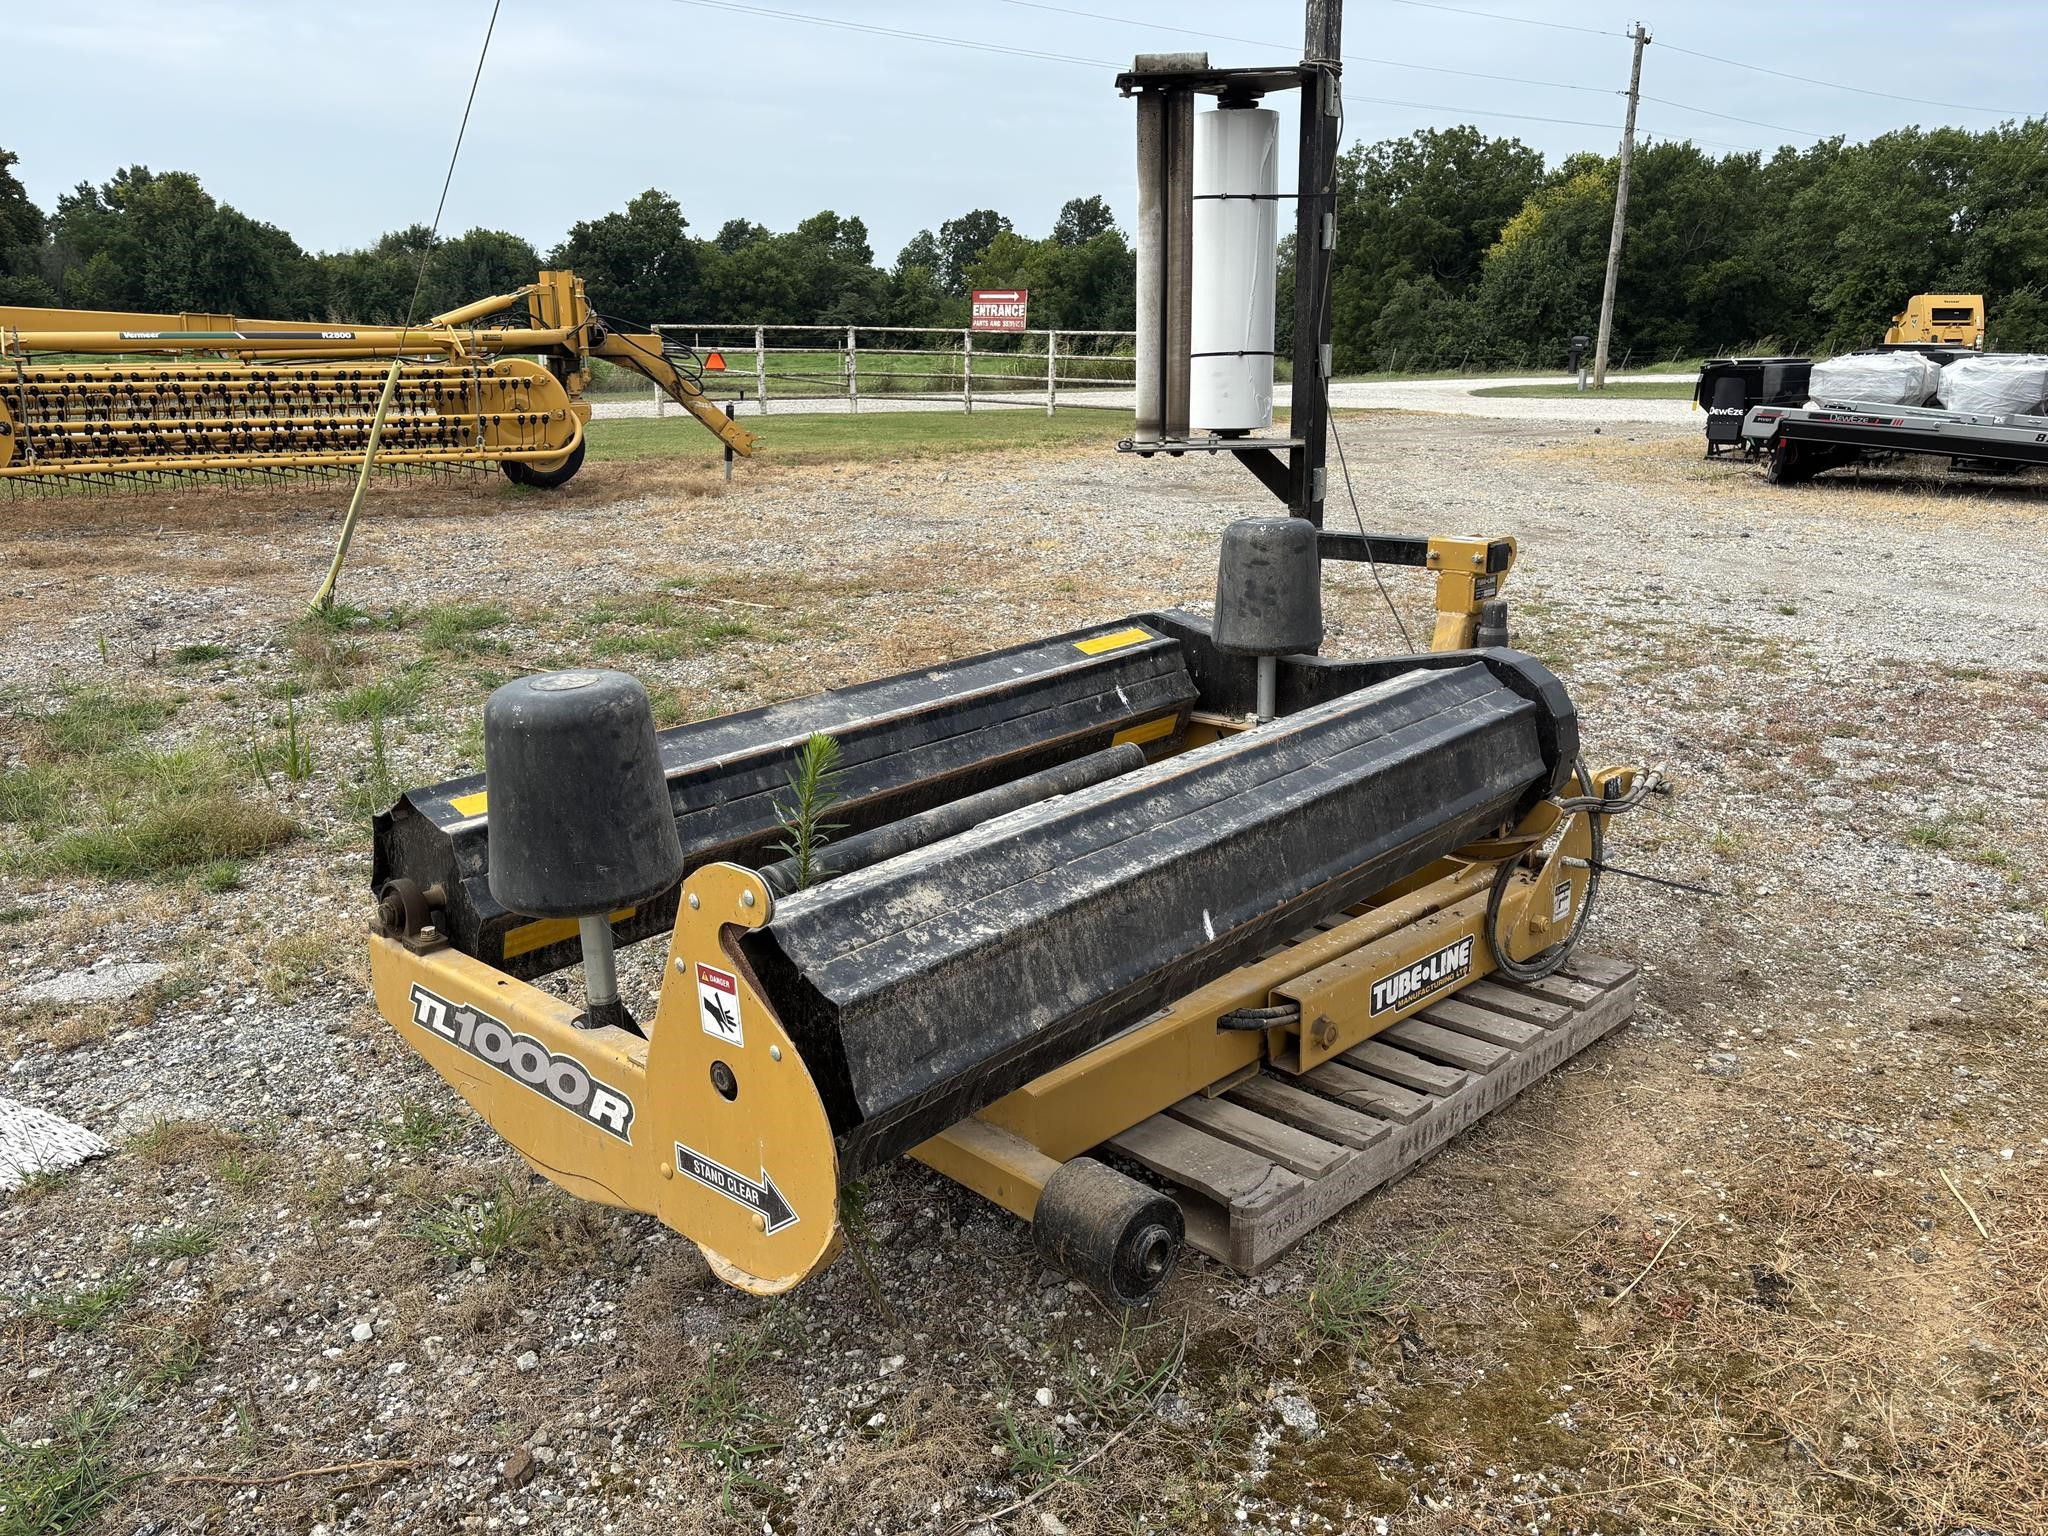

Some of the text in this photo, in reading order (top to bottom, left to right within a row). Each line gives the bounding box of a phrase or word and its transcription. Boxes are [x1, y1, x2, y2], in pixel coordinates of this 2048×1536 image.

[972, 304, 1025, 317] ENTRANCE
[972, 320, 1024, 329] PARTS AND SERVICE
[709, 974, 731, 989] DANGER
[1397, 973, 1455, 1008] MANUFACTURING
[414, 990, 629, 1134] TL1000R
[693, 1160, 760, 1206] STAND CLEAR
